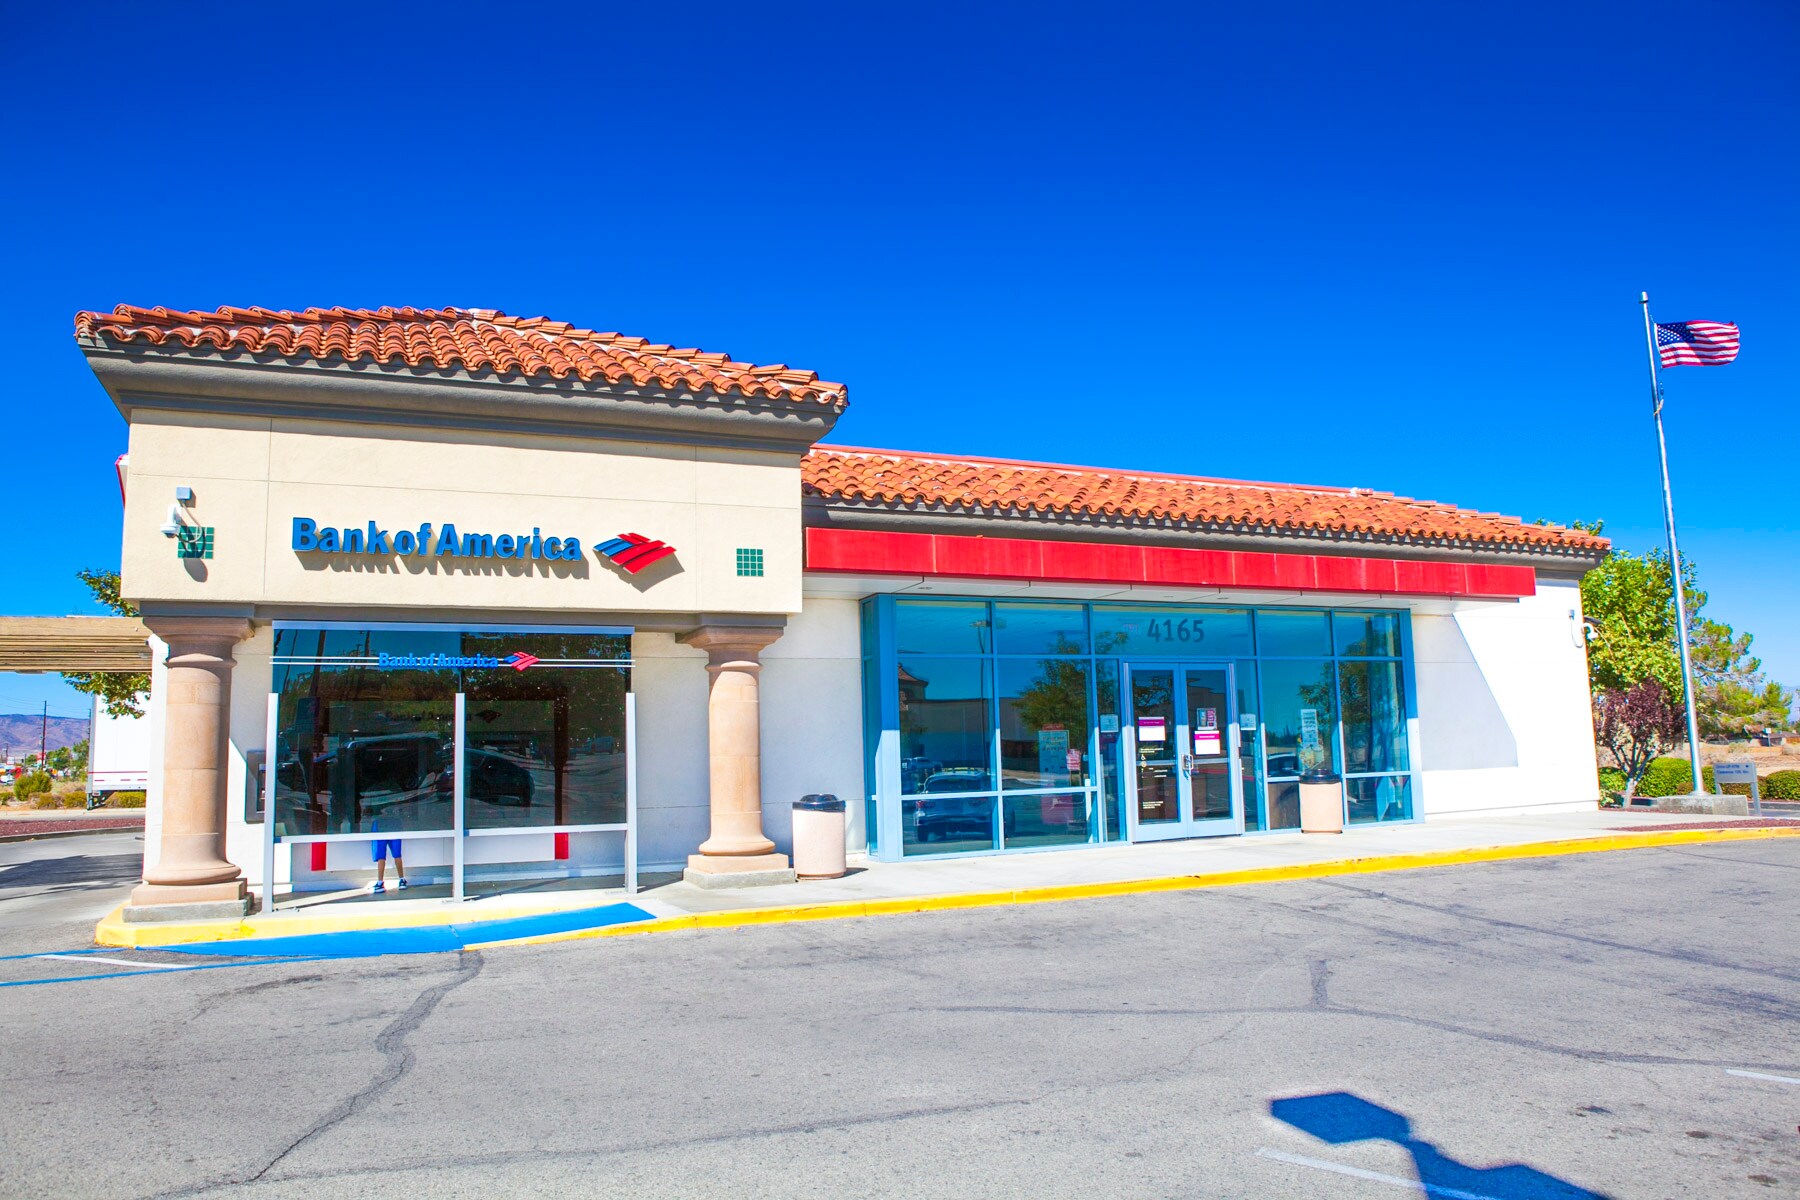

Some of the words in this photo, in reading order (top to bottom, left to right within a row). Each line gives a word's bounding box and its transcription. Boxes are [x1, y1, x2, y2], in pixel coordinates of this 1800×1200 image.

[292, 517, 389, 554] Bank
[394, 523, 431, 556] of
[435, 523, 582, 561] America
[1147, 618, 1205, 642] 4165
[379, 652, 417, 667] Bank
[419, 653, 435, 667] of
[437, 653, 498, 668] America
